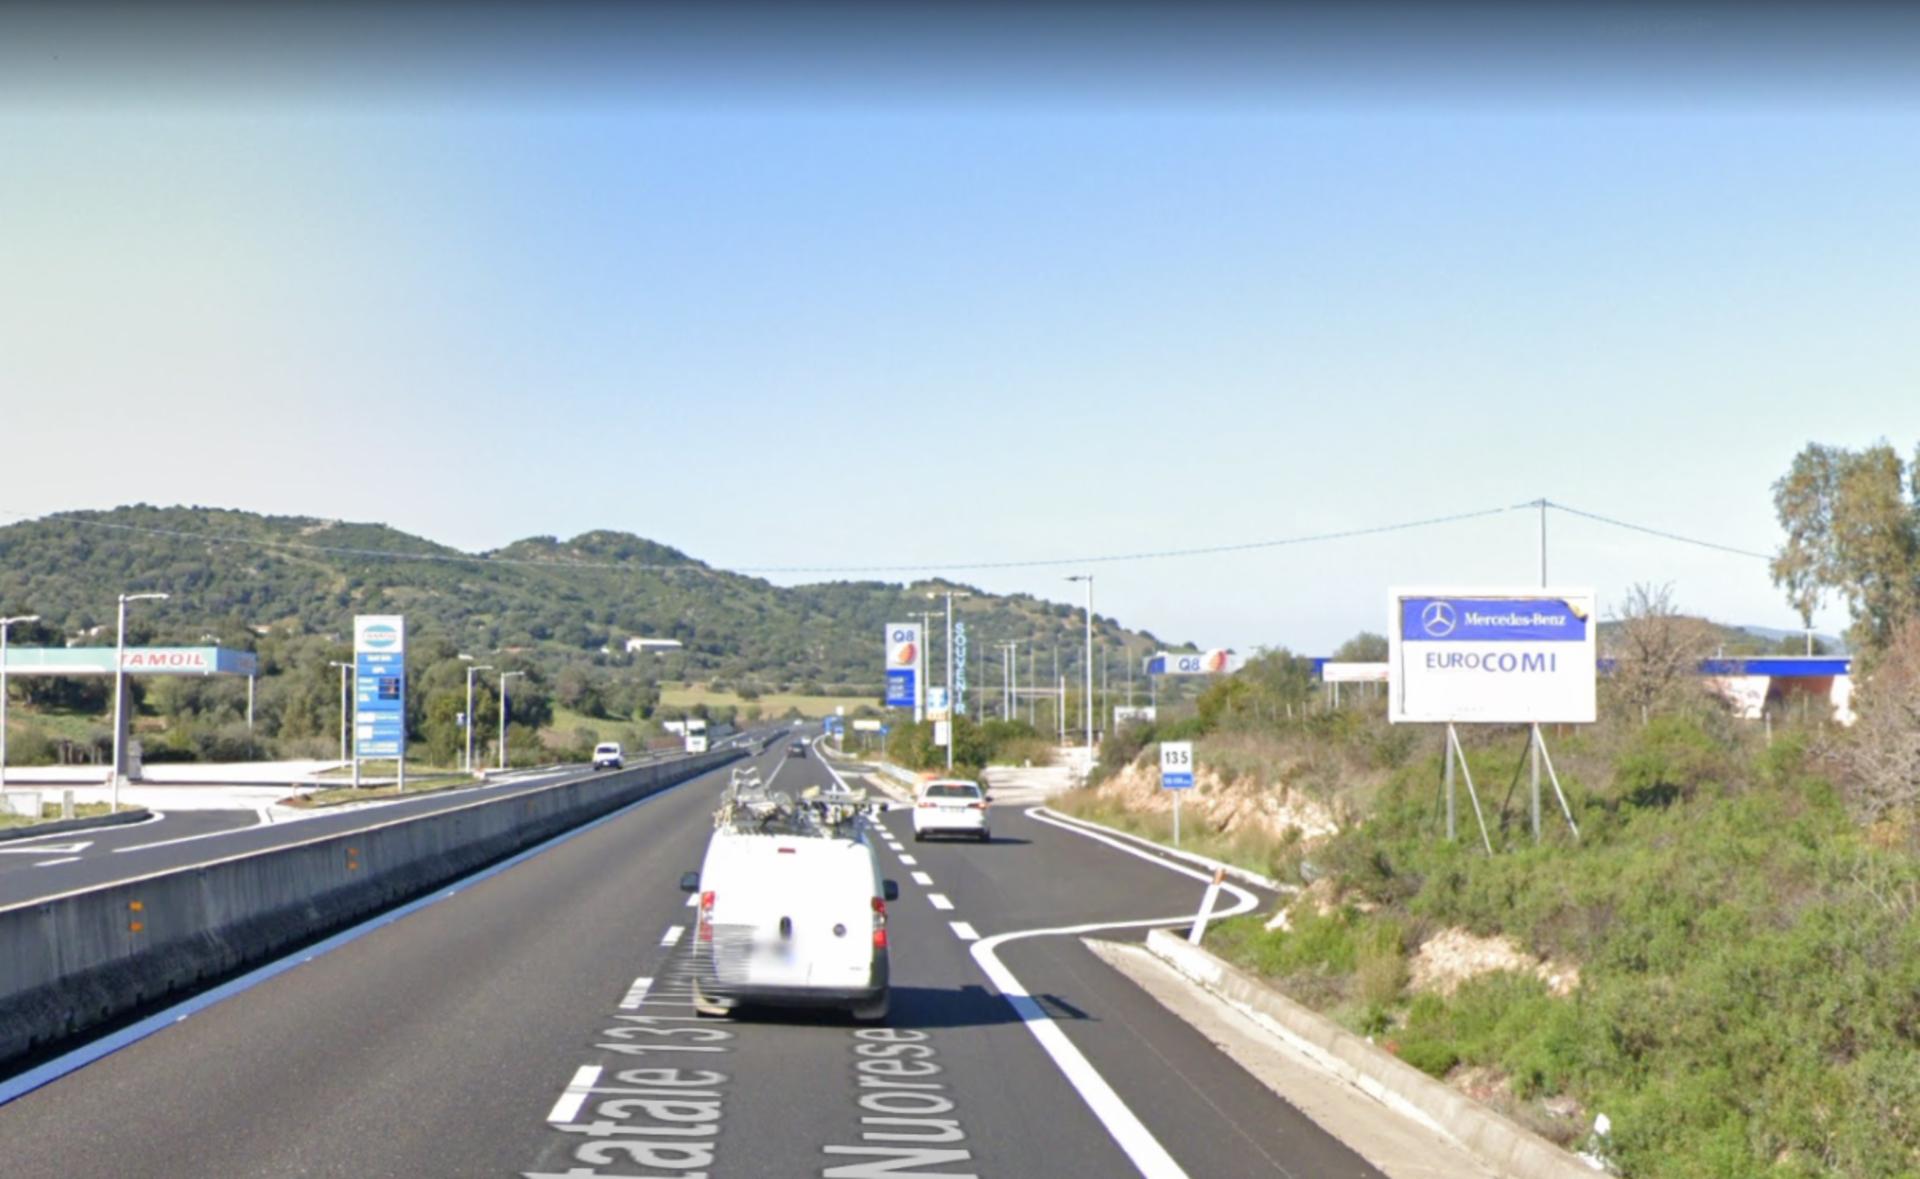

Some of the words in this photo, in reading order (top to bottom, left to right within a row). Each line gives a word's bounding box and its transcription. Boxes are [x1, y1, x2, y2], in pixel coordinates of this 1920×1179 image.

[1464, 612, 1566, 626] Mercedes-Benz
[893, 629, 914, 643] Q8
[955, 622, 967, 715] SOUVENIR
[1179, 657, 1200, 671] Q8
[1165, 751, 1189, 765] 135
